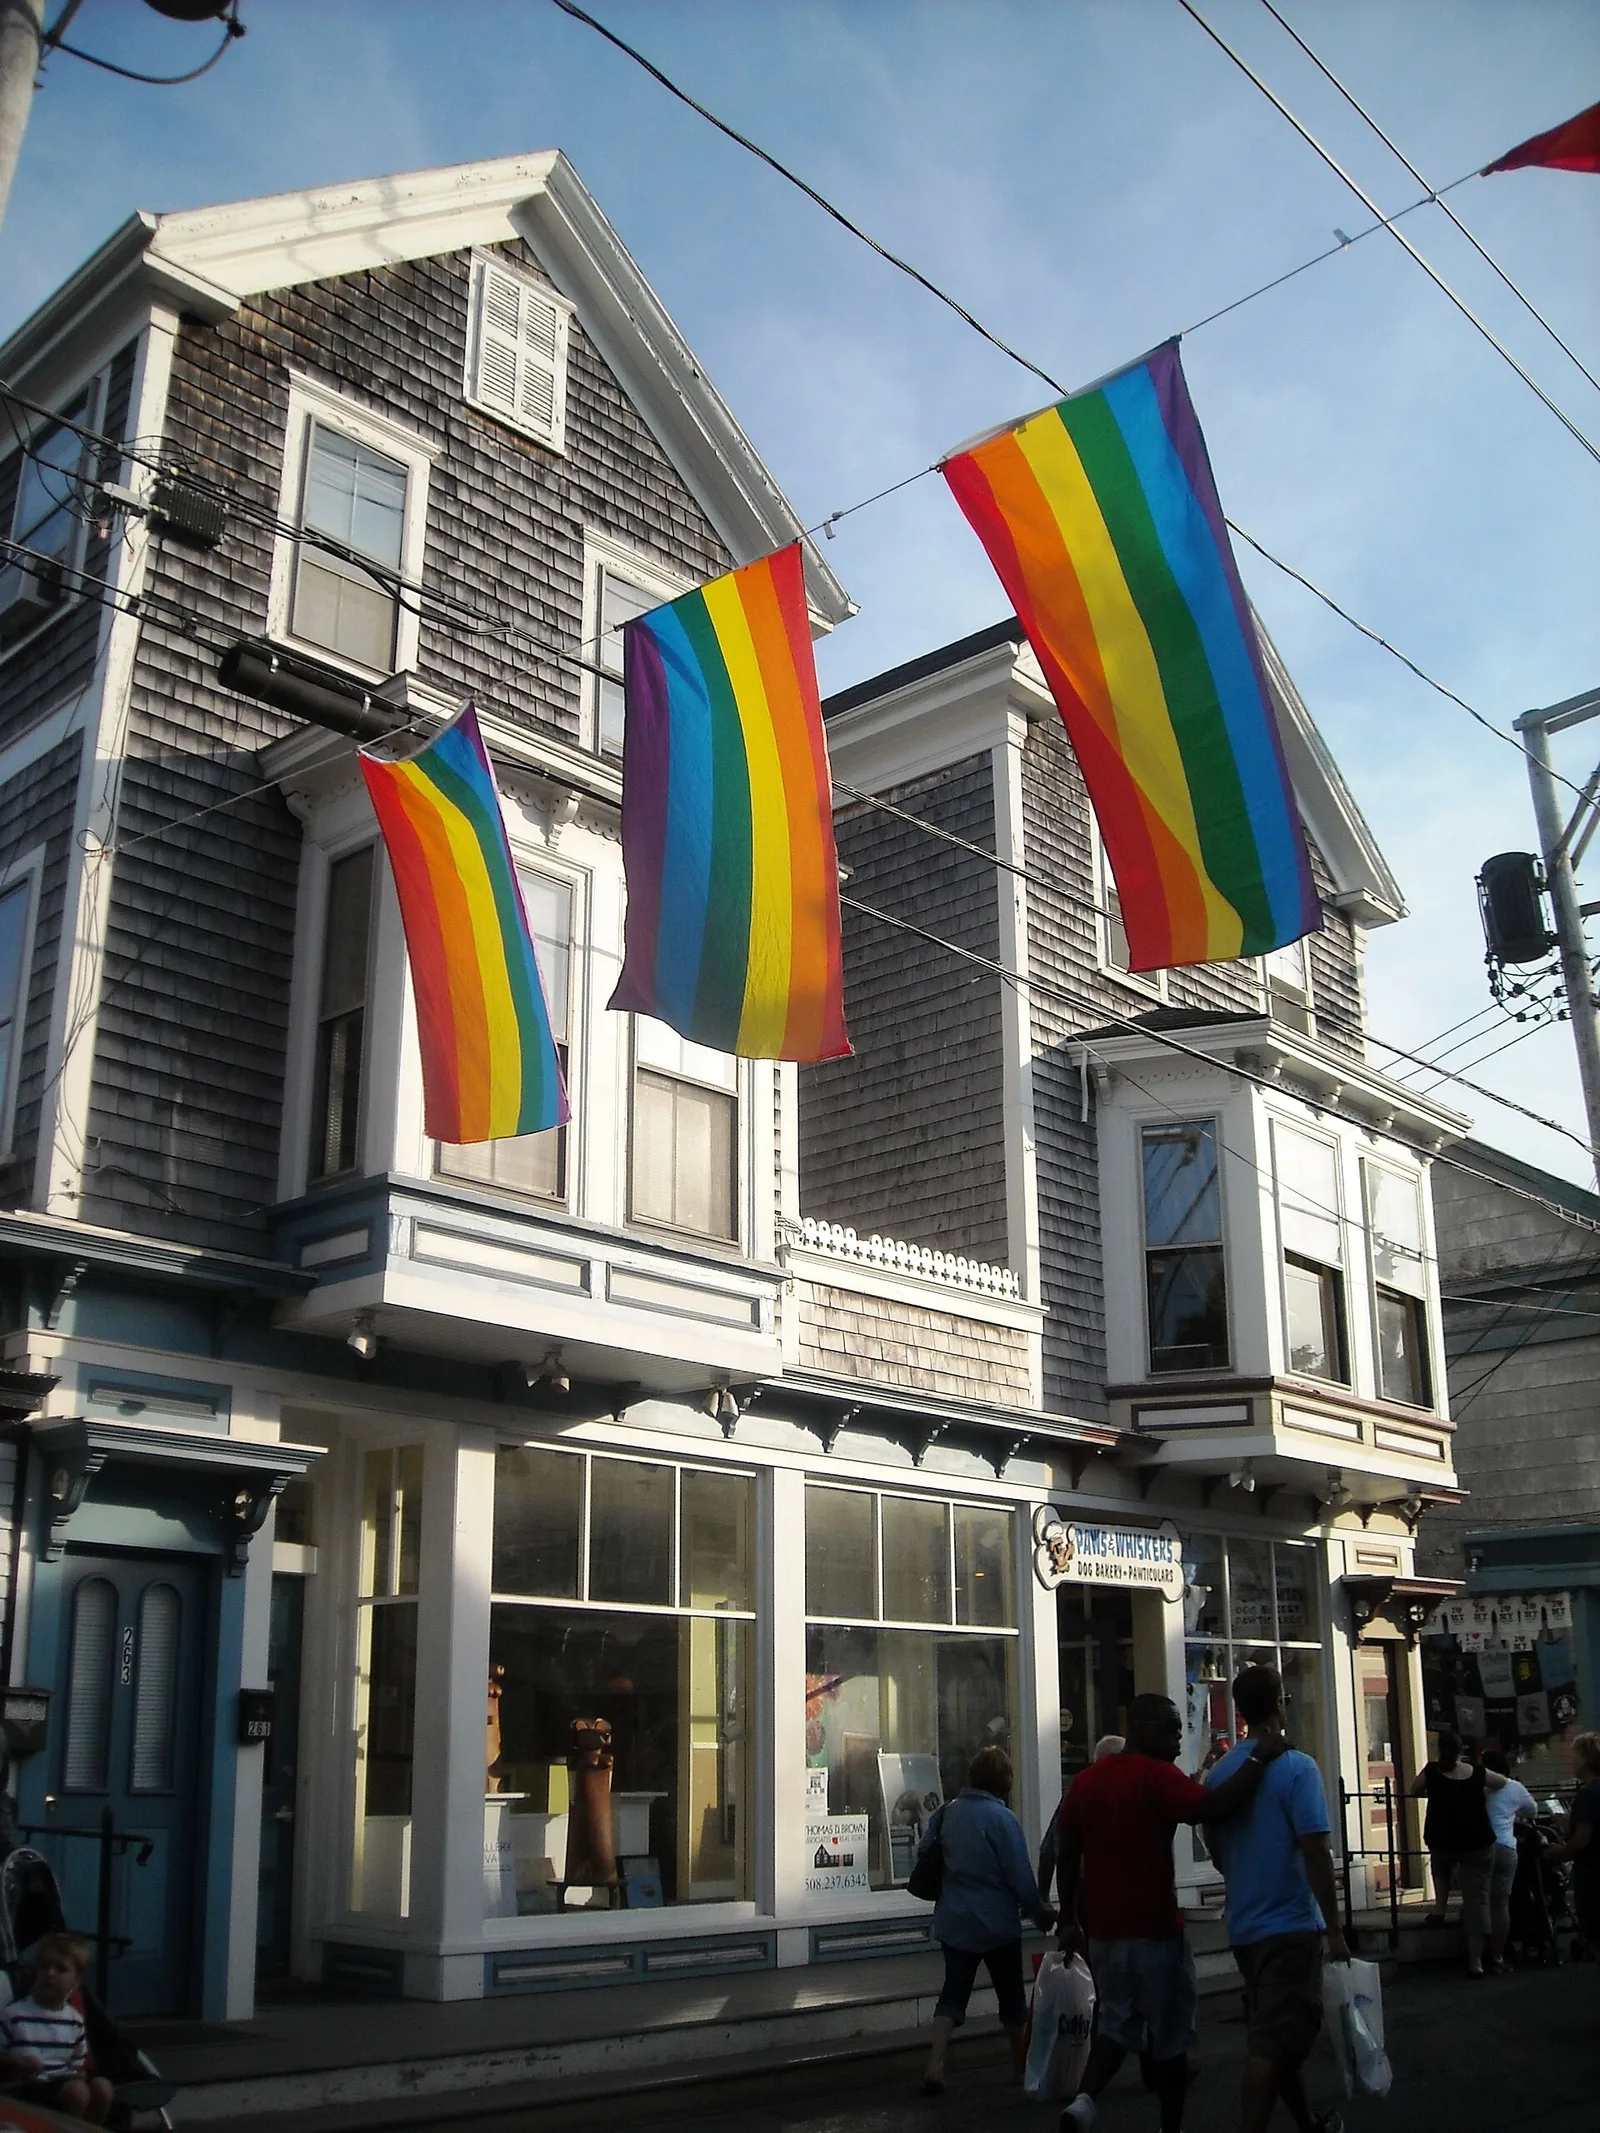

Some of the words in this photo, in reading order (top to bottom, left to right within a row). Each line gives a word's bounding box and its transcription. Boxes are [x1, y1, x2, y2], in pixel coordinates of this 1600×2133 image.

[1075, 1527, 1107, 1558] PAWS
[1108, 1533, 1115, 1555] &
[1115, 1531, 1173, 1564] WHISKERS
[1077, 1561, 1093, 1577] DOG
[1095, 1563, 1122, 1580] BAKERY
[1128, 1565, 1174, 1584] PAWTICULARS
[122, 1628, 133, 1683] 263
[249, 1722, 269, 1736] 261
[842, 1823, 866, 1834] BROWN
